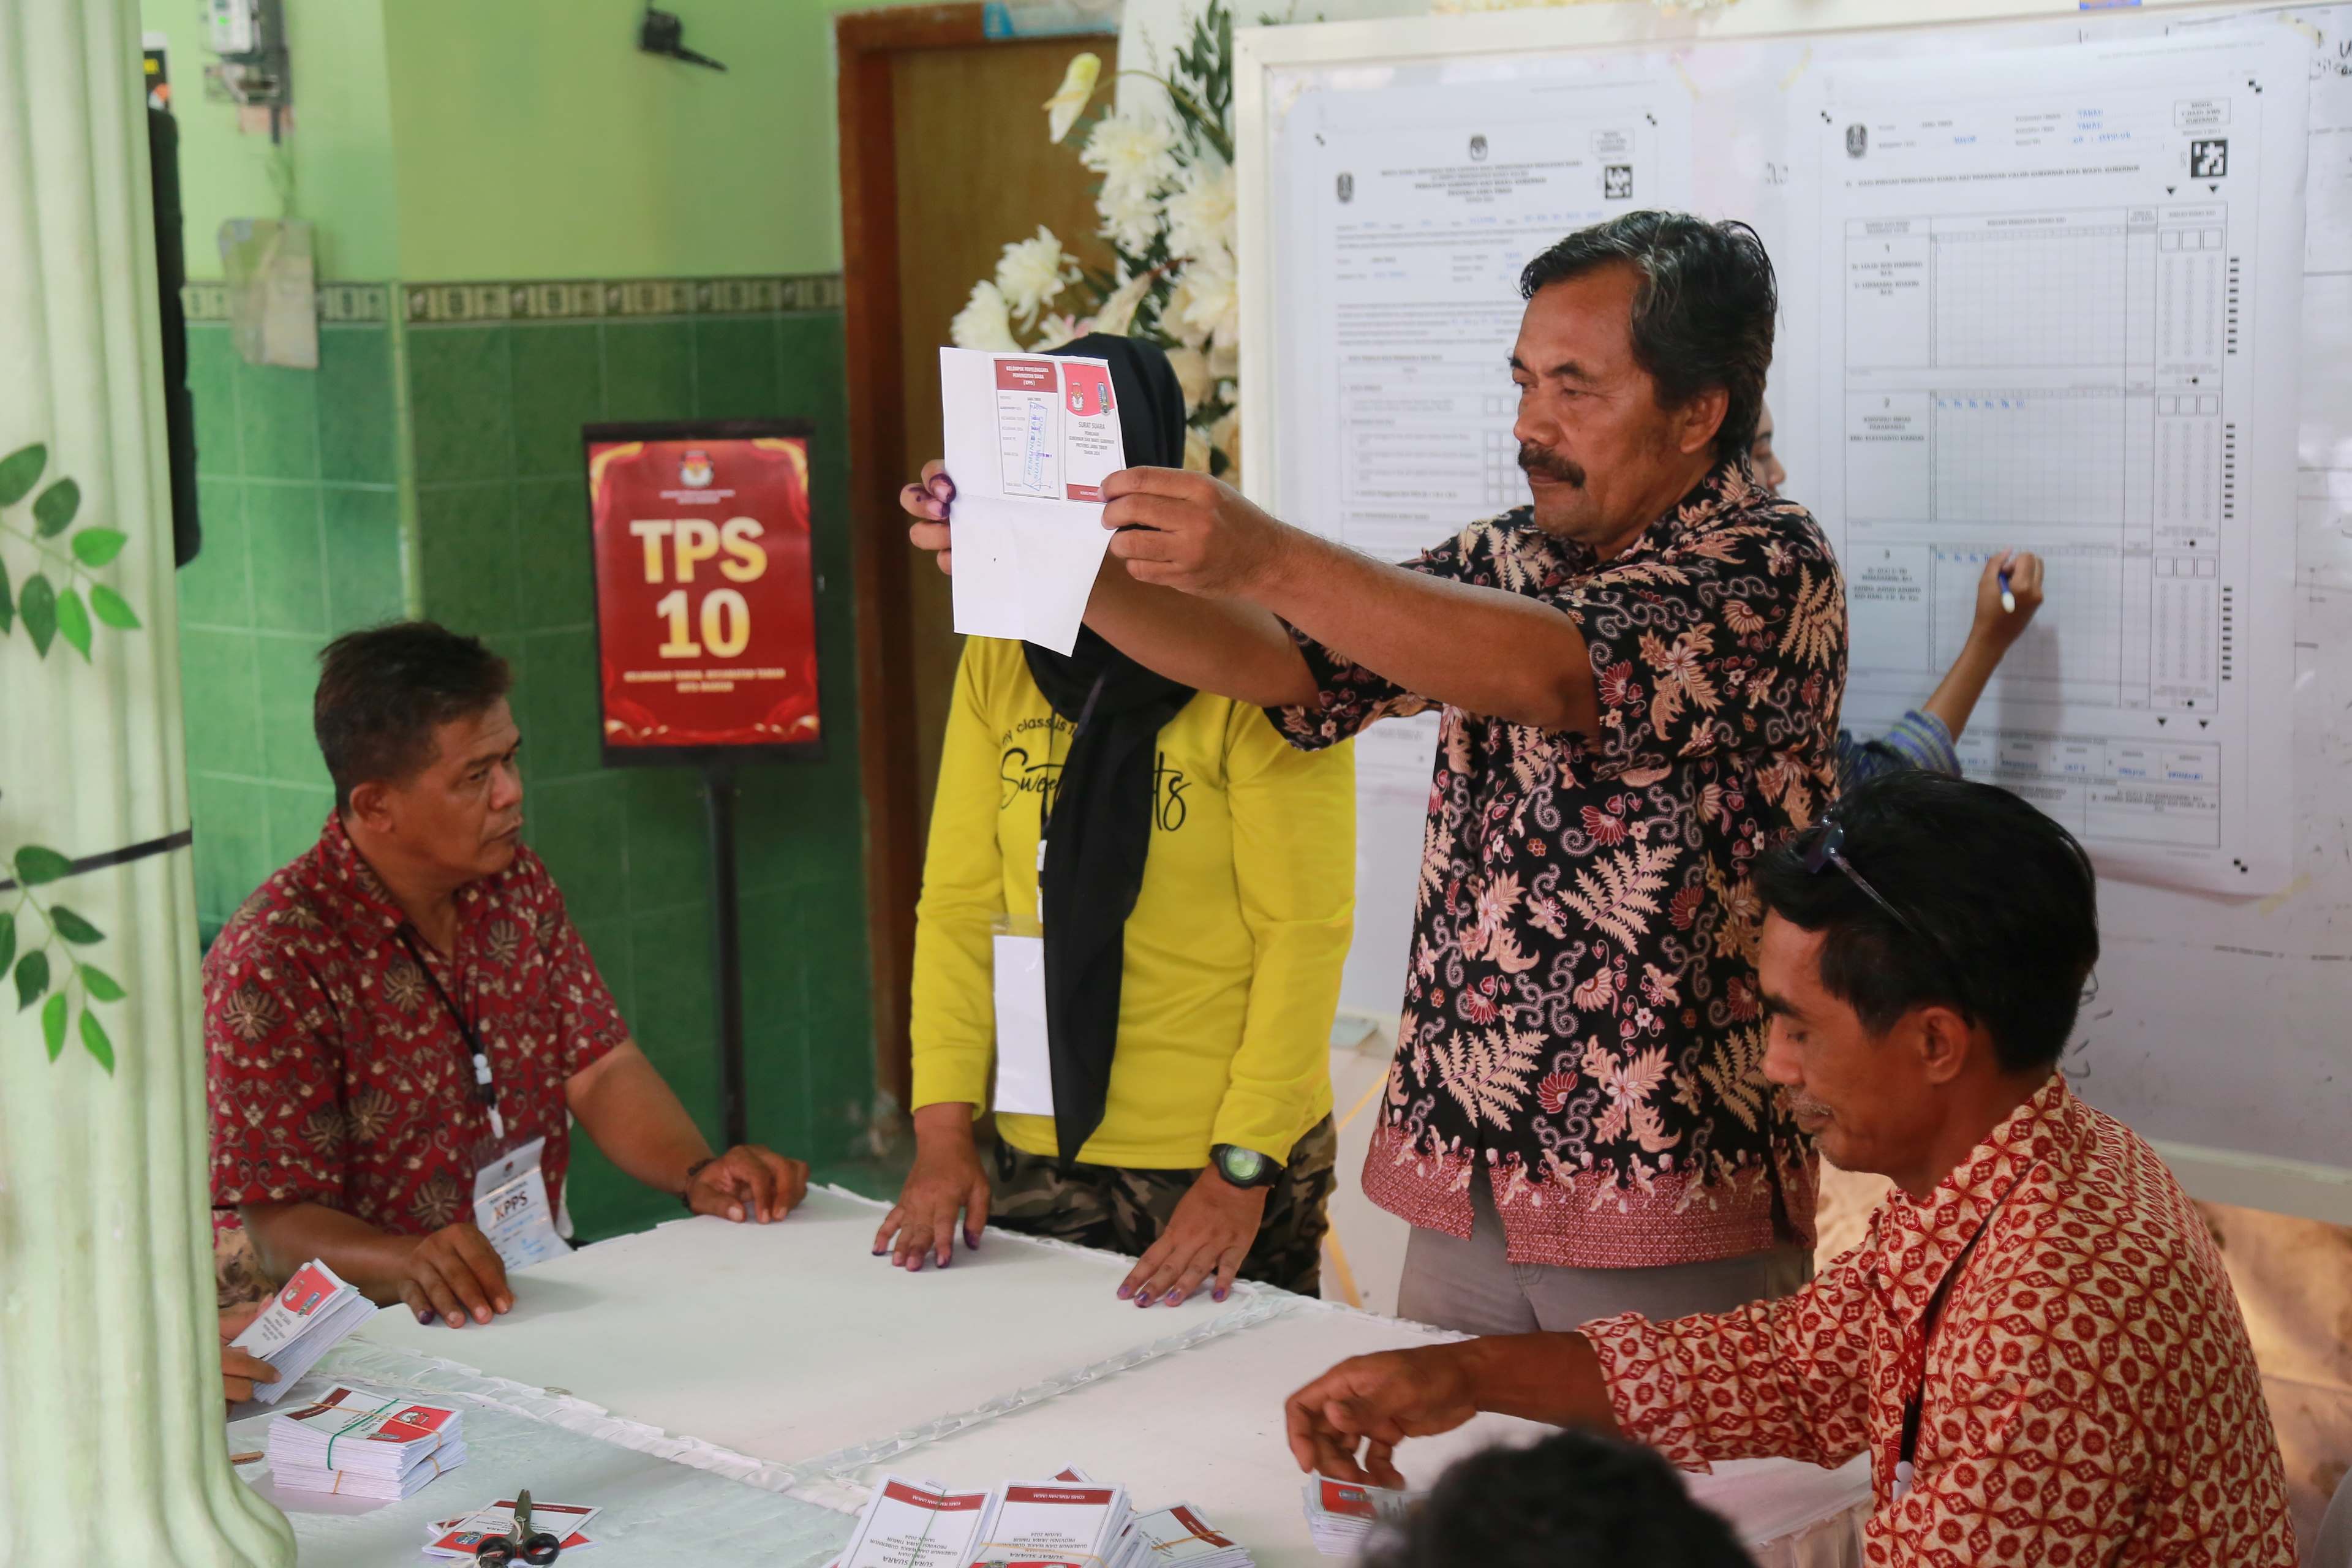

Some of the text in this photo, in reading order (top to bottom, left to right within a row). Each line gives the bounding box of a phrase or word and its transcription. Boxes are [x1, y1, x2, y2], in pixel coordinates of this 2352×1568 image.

[629, 516, 767, 584] TPS
[656, 587, 750, 658] 10
[1017, 718, 1052, 733] class
[1054, 718, 1067, 732] is
[869, 1539, 899, 1550] GUBERNUR
[886, 1536, 905, 1545] TIMUR
[883, 1556, 909, 1566] SUARA
